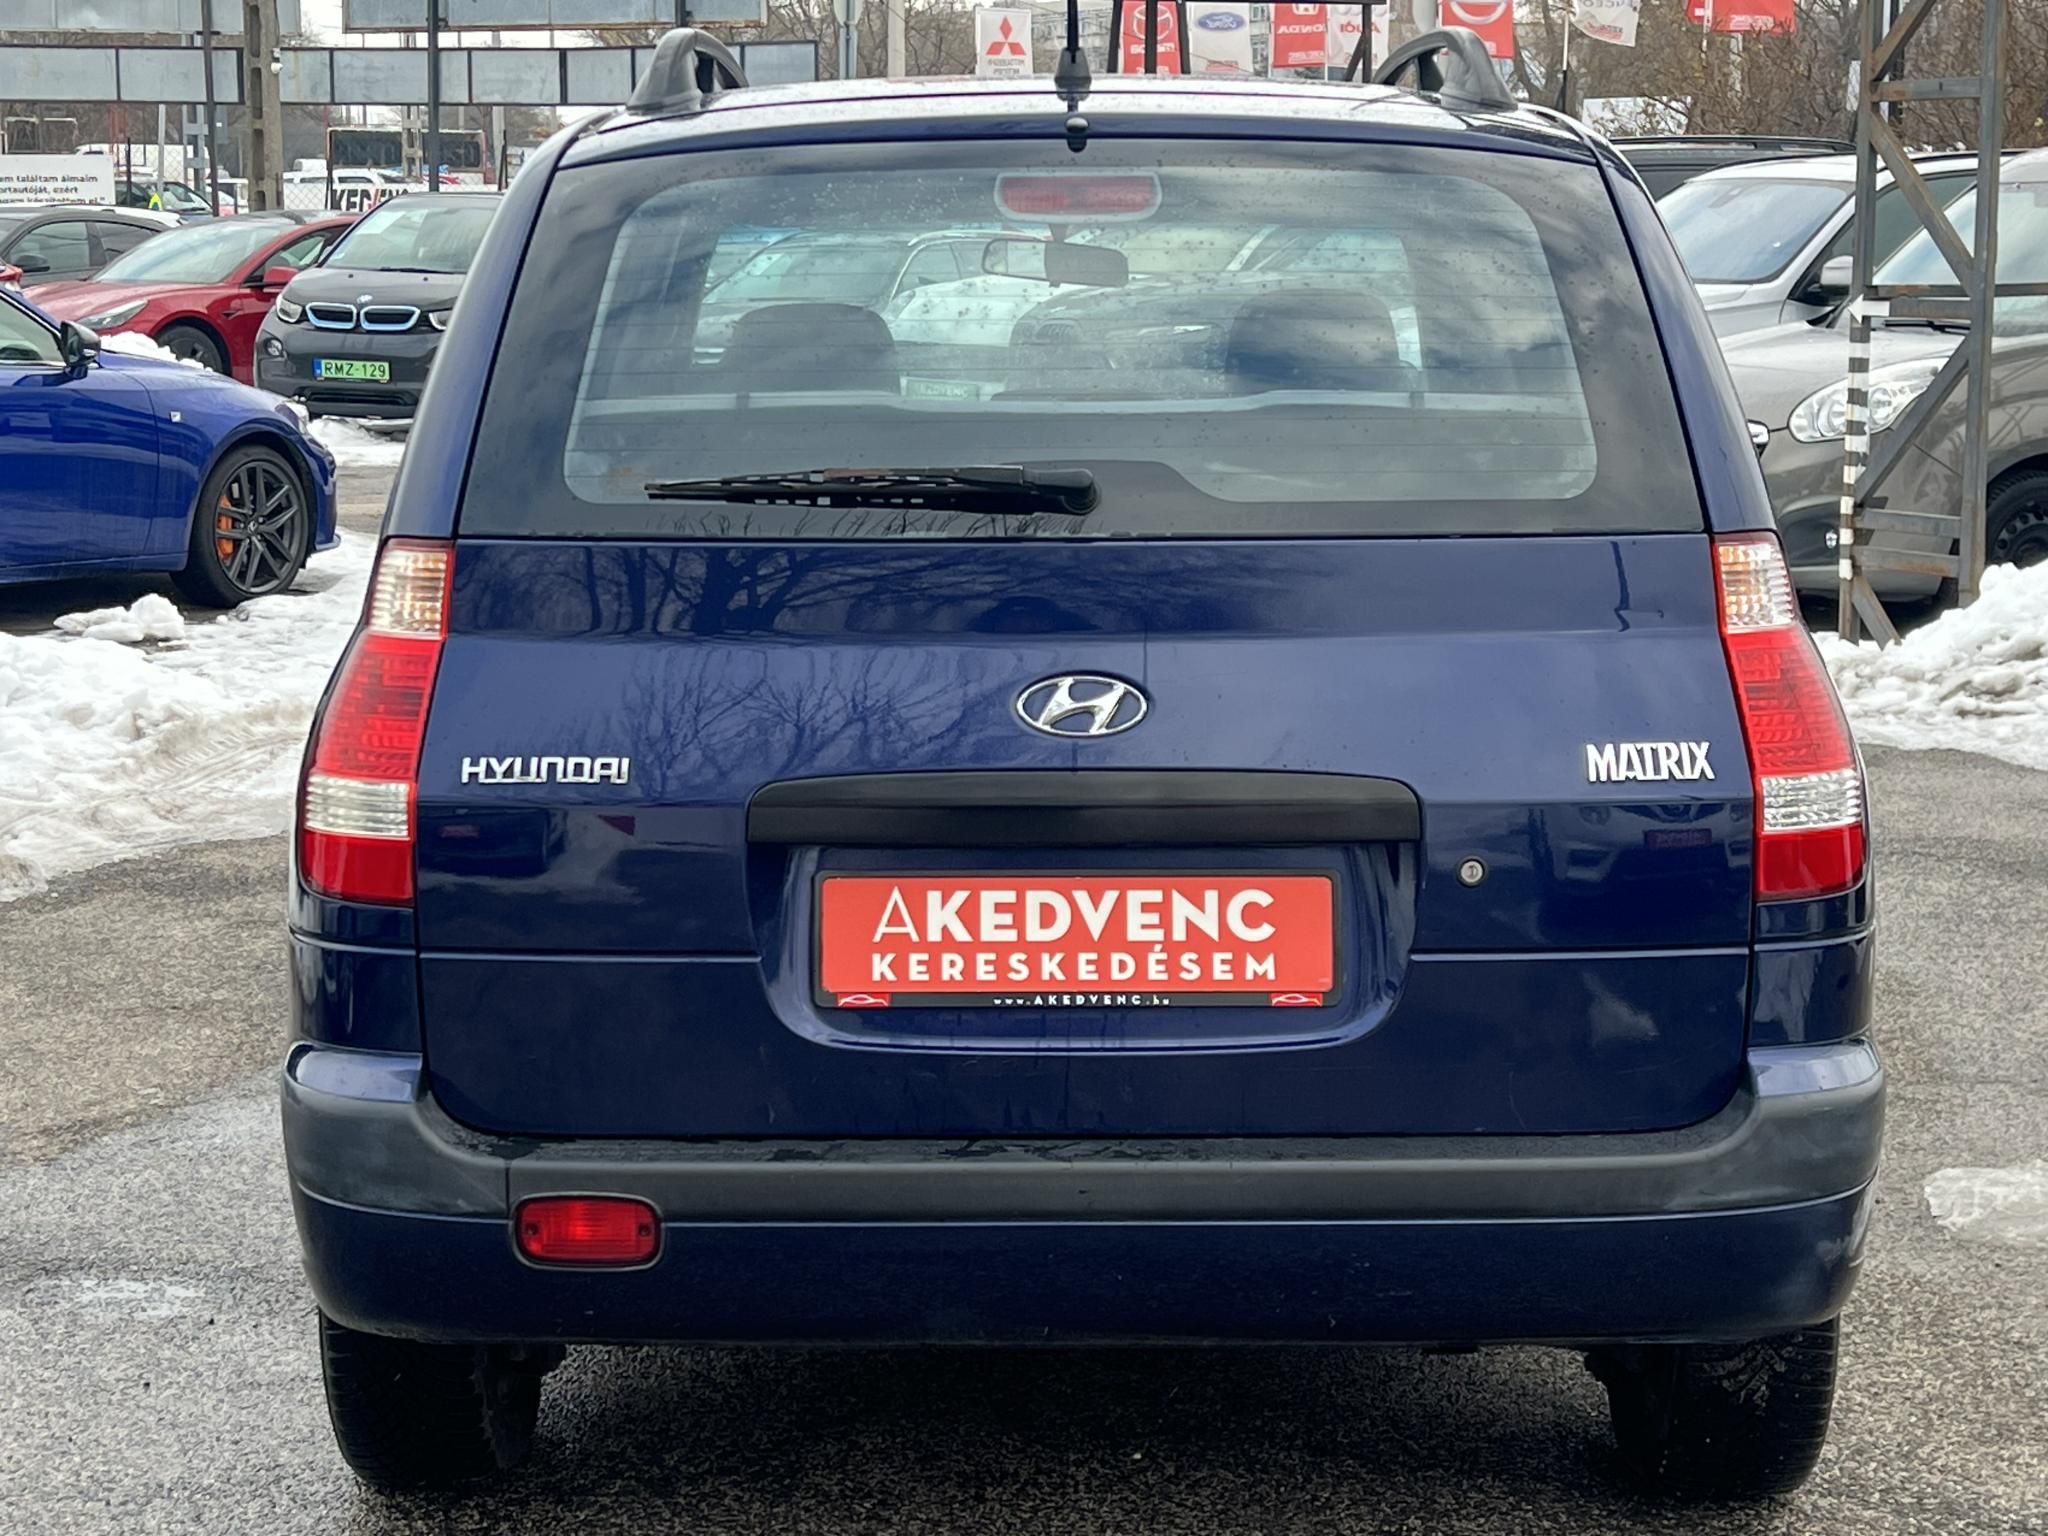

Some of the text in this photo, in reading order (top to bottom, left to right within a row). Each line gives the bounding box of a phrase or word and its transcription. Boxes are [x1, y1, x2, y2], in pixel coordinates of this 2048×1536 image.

[324, 361, 386, 378] RMZ-129
[461, 756, 630, 784] HYUNDAI
[1586, 741, 1716, 782] MATRIX
[872, 944, 1276, 981] KERESKEDÉSEM
